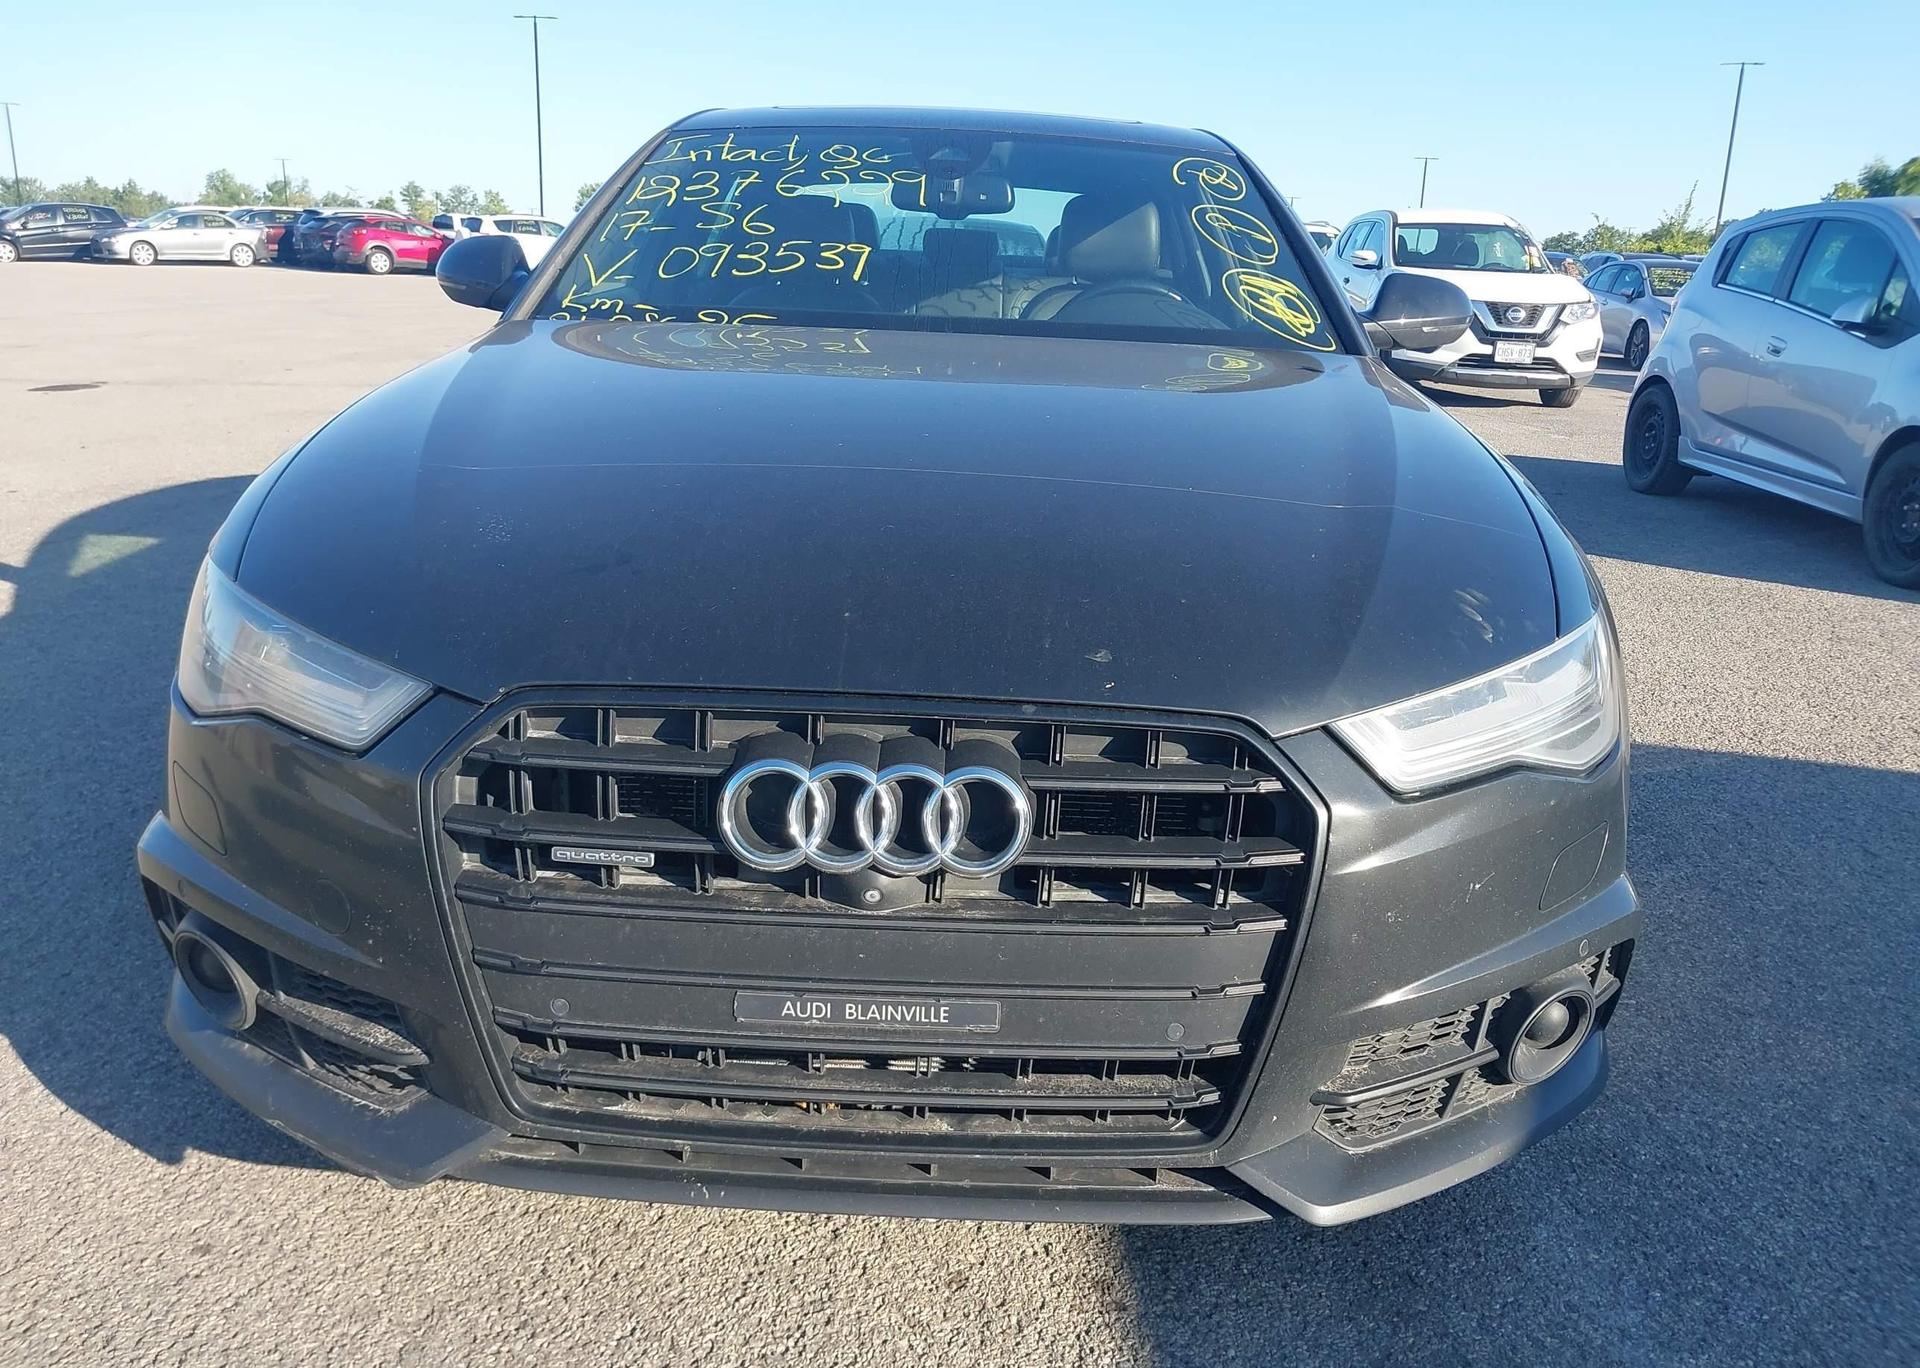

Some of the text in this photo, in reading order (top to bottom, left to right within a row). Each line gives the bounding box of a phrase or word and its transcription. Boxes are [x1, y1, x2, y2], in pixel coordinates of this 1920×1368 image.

[658, 240, 872, 281] 093539
[556, 850, 649, 863] quattro
[781, 1001, 949, 1023] AUDI BLAINVILLE
